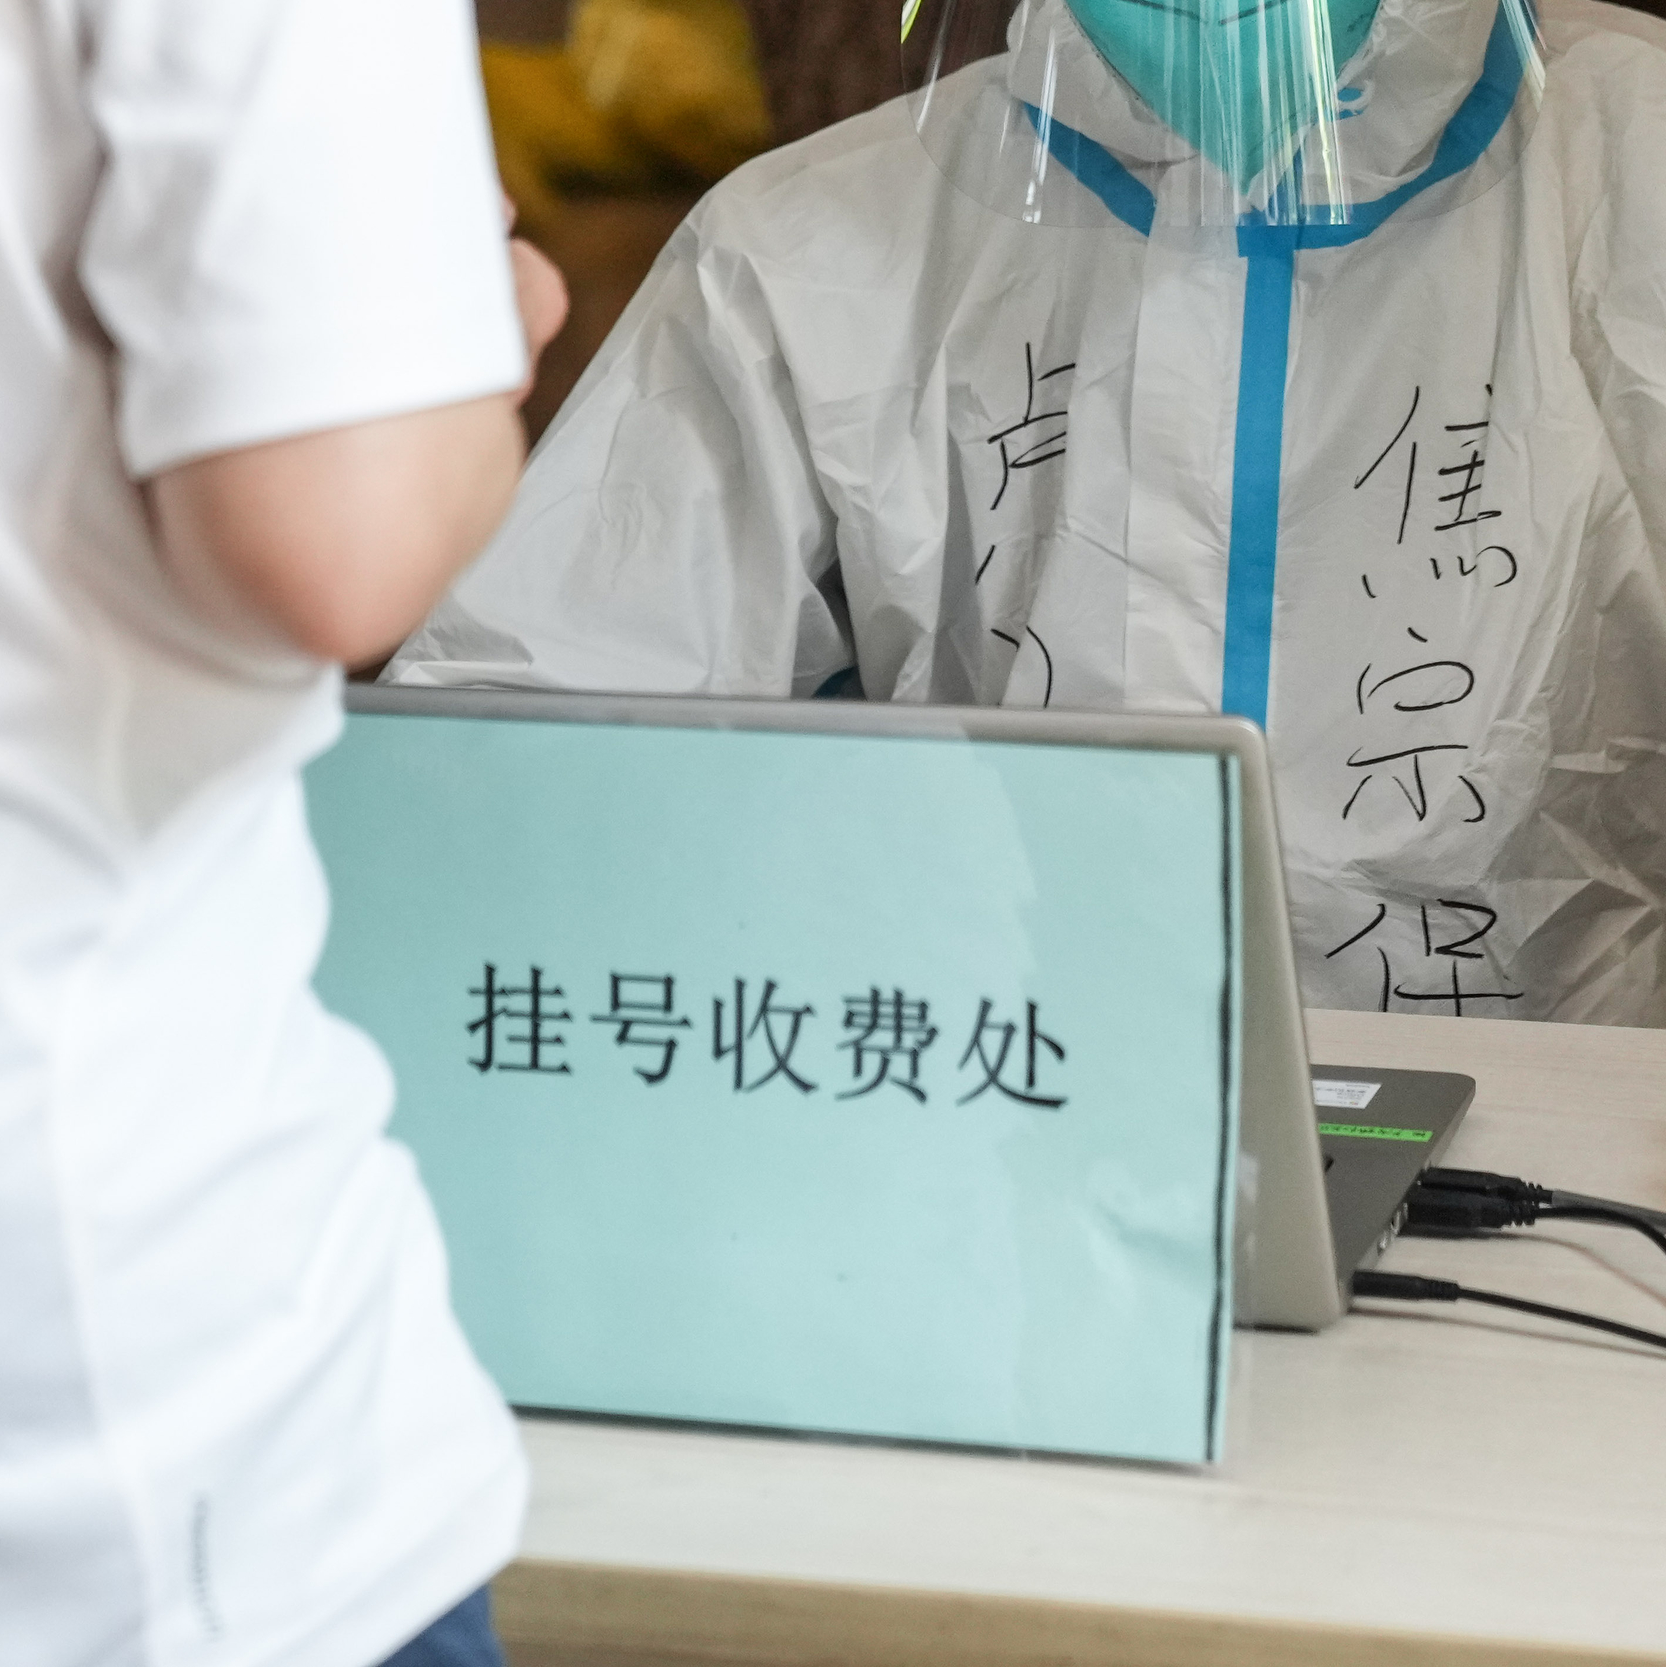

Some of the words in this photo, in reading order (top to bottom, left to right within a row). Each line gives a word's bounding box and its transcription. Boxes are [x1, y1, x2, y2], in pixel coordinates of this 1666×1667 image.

[465, 961, 1069, 1111] 挂号收费处
